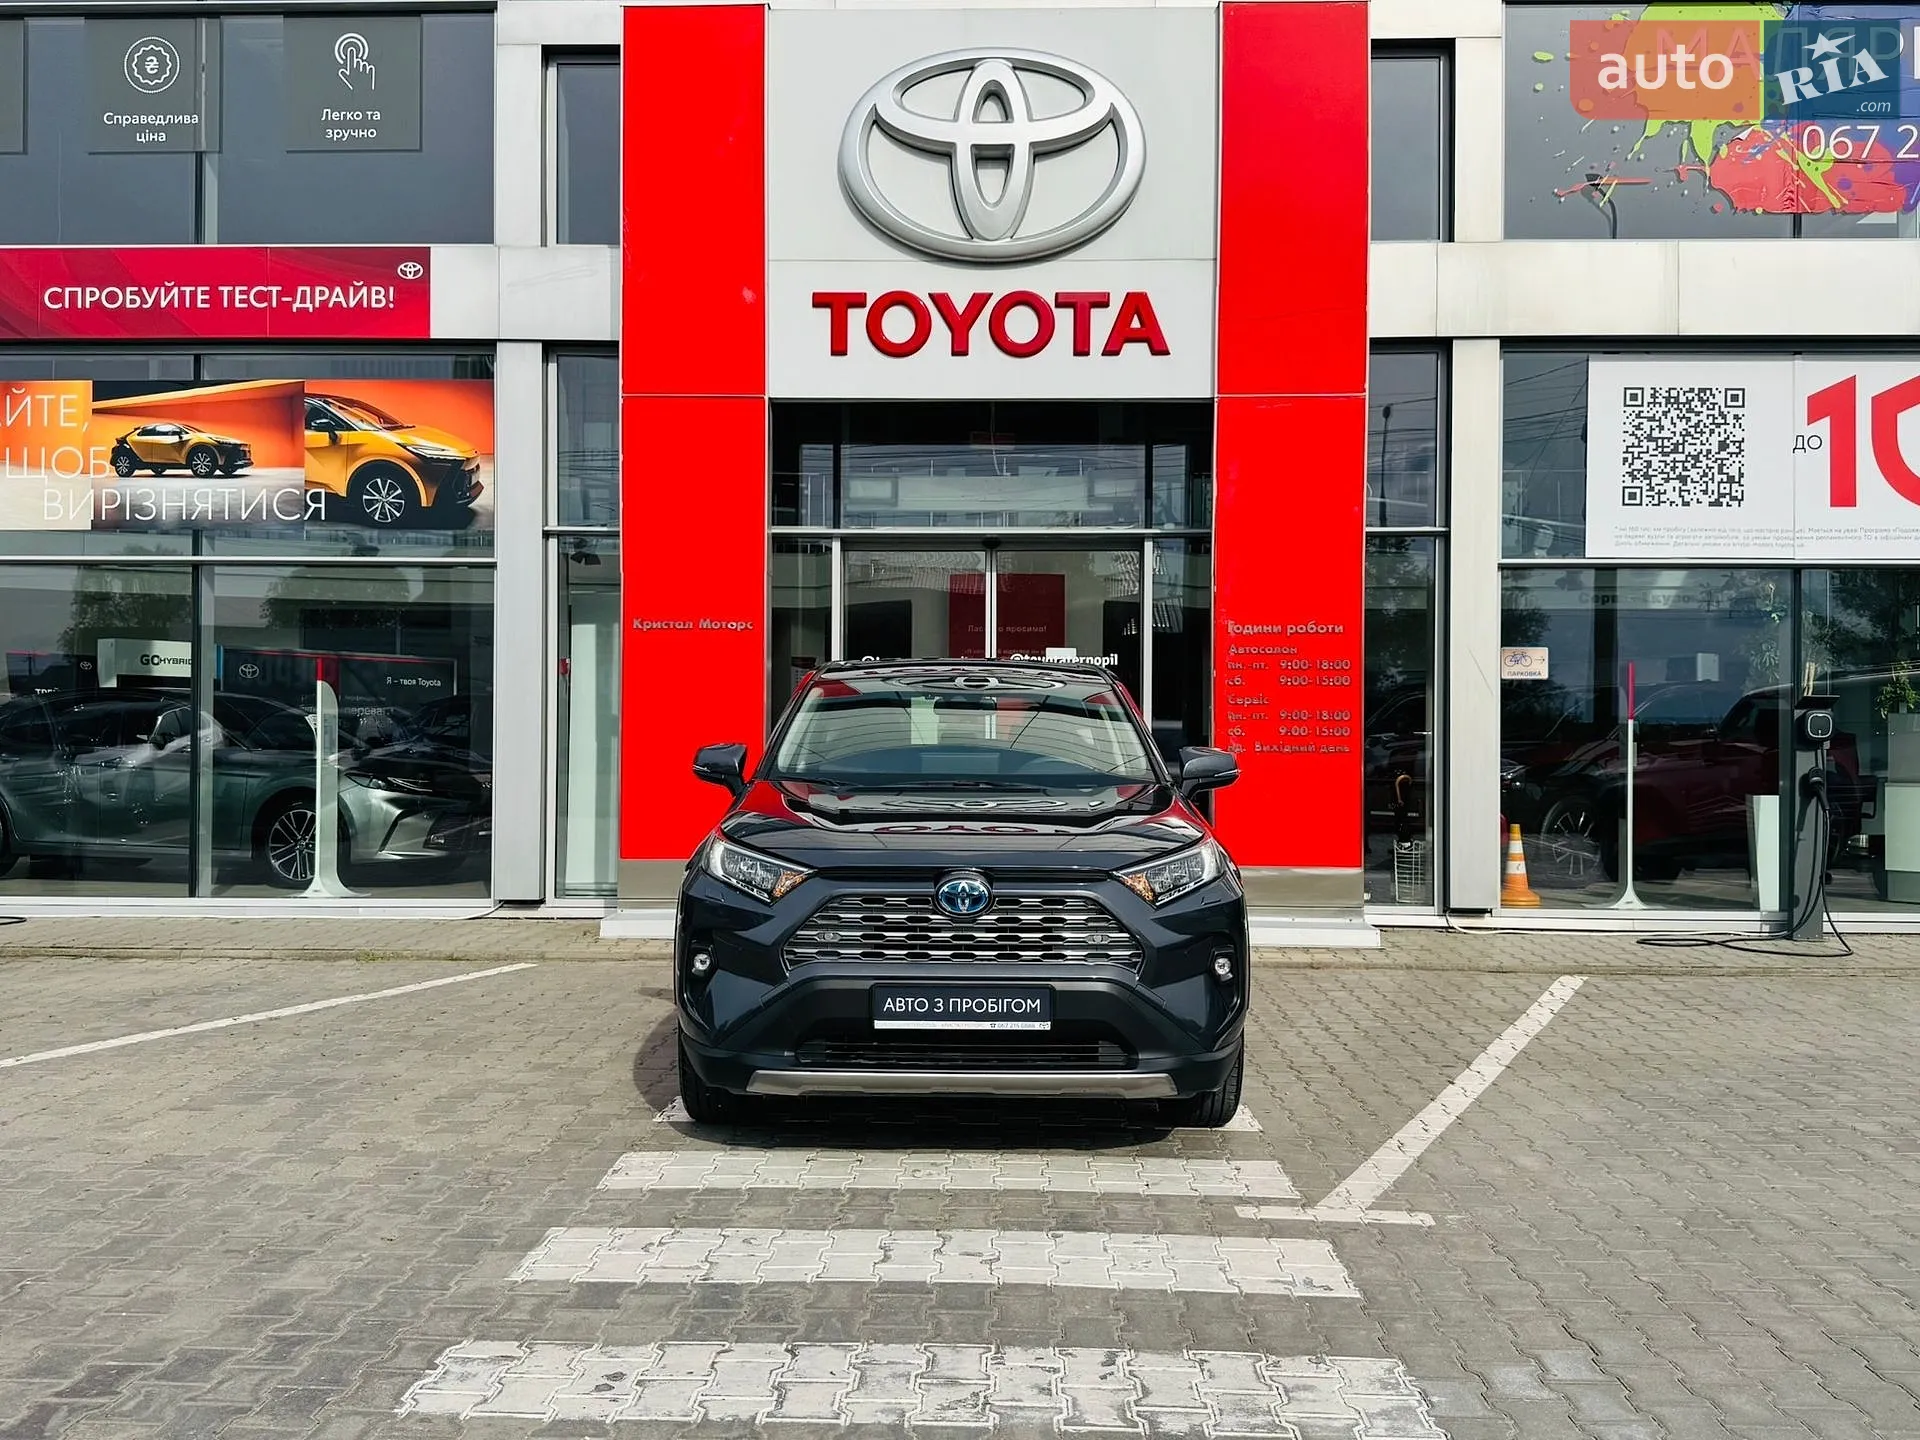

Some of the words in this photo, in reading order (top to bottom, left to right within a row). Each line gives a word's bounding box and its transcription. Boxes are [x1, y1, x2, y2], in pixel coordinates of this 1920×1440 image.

[103, 111, 199, 127] Справедлива
[321, 108, 363, 122] Легко
[366, 110, 381, 121] та
[136, 129, 167, 144] ціна
[325, 126, 377, 141] зручно
[1802, 125, 1880, 160] 067
[43, 281, 210, 311] СПРОБУЙТЕ
[217, 281, 395, 312] ТЕСТ-ДРАЙВ!
[811, 290, 1171, 358] TOYOTA
[0, 387, 90, 432] ЙТЕ,
[6, 446, 110, 485] ЩОБ
[43, 488, 326, 521] ВИРІЗНЯТИСЯ
[632, 618, 693, 632] Кристал
[698, 618, 754, 632] Моторс
[1227, 620, 1282, 635] Години
[1286, 620, 1344, 636] роботи
[1229, 643, 1298, 654] Автосалон
[418, 677, 442, 688] Toyota
[1227, 692, 1270, 708] Сервіс
[883, 997, 929, 1013] АВТО
[933, 998, 944, 1013] З
[949, 998, 1041, 1014] ПРОБІГОМ
